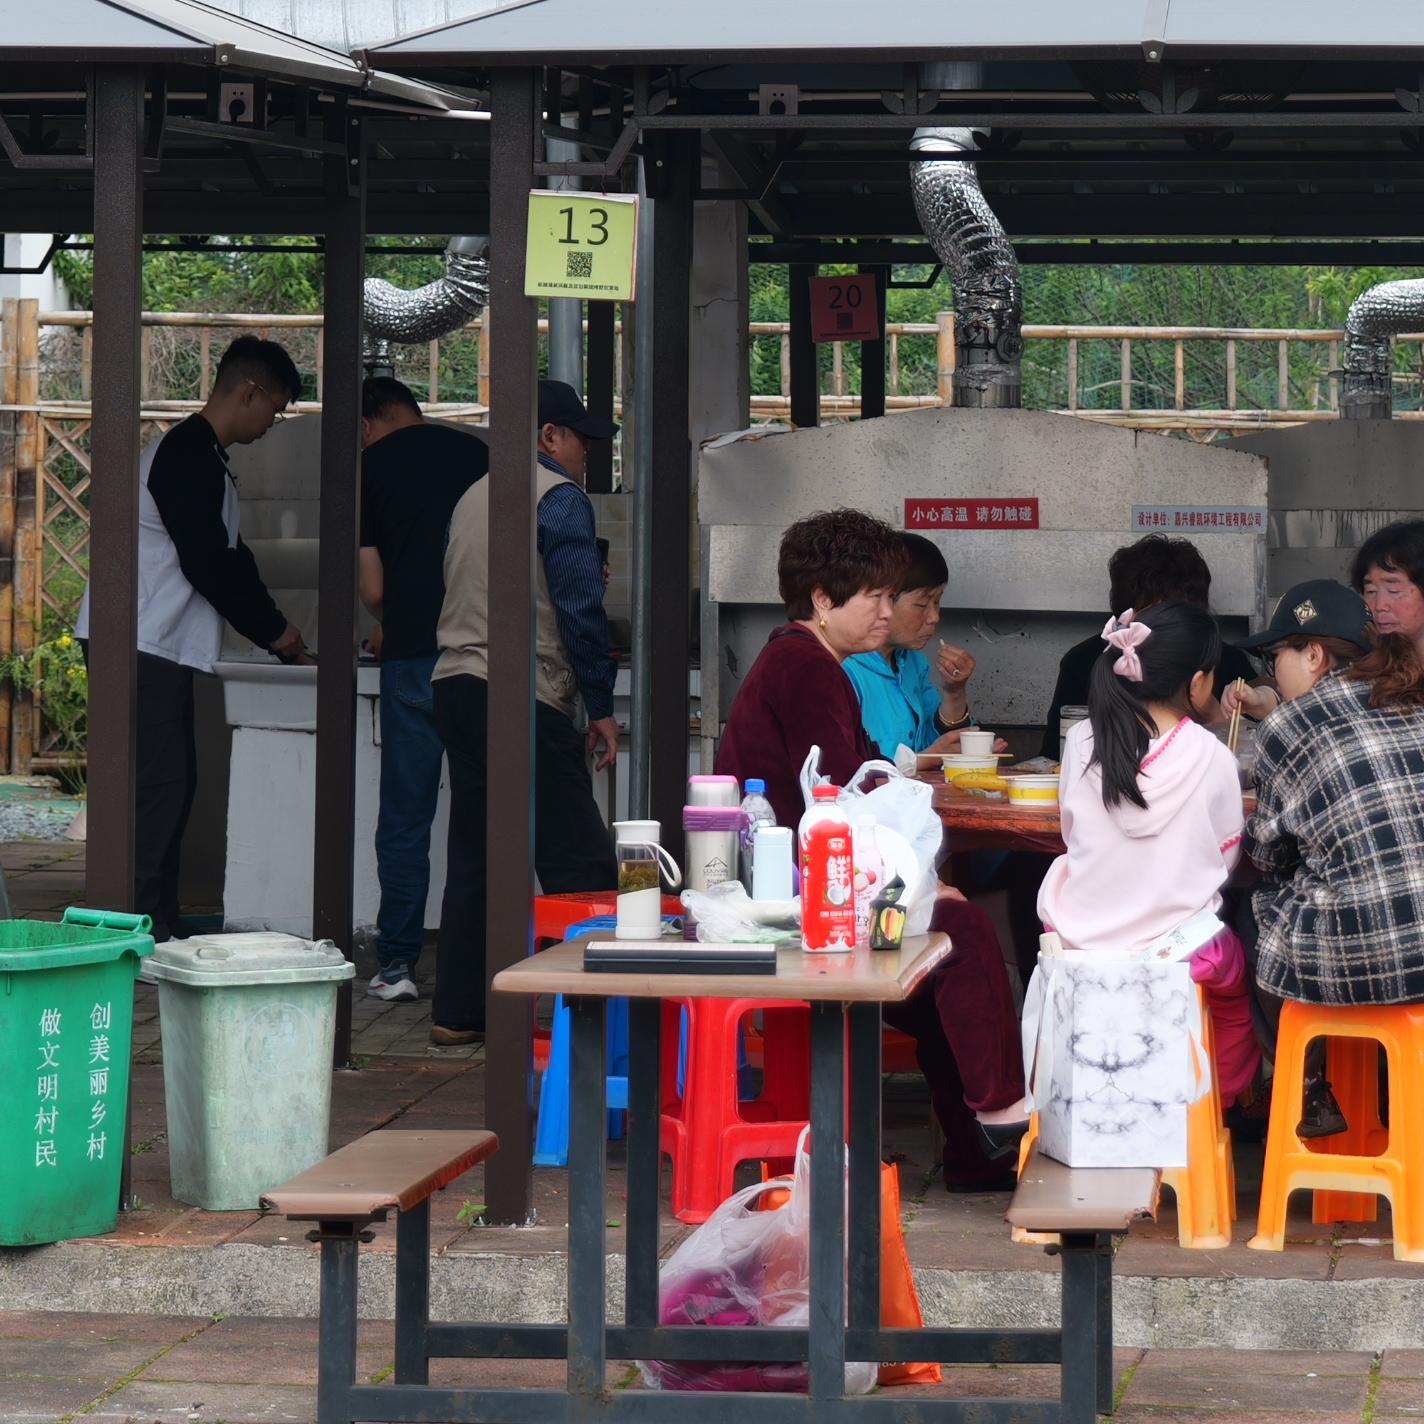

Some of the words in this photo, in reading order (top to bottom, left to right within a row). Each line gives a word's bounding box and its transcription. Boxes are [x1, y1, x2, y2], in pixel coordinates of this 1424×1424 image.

[558, 207, 609, 245] 13
[828, 284, 862, 309] 20
[911, 505, 969, 523] 小心高温
[975, 504, 1033, 522] 请勿触碰
[35, 1008, 62, 1168] 做文明村民
[86, 1001, 112, 1161] 创美丽乡村
